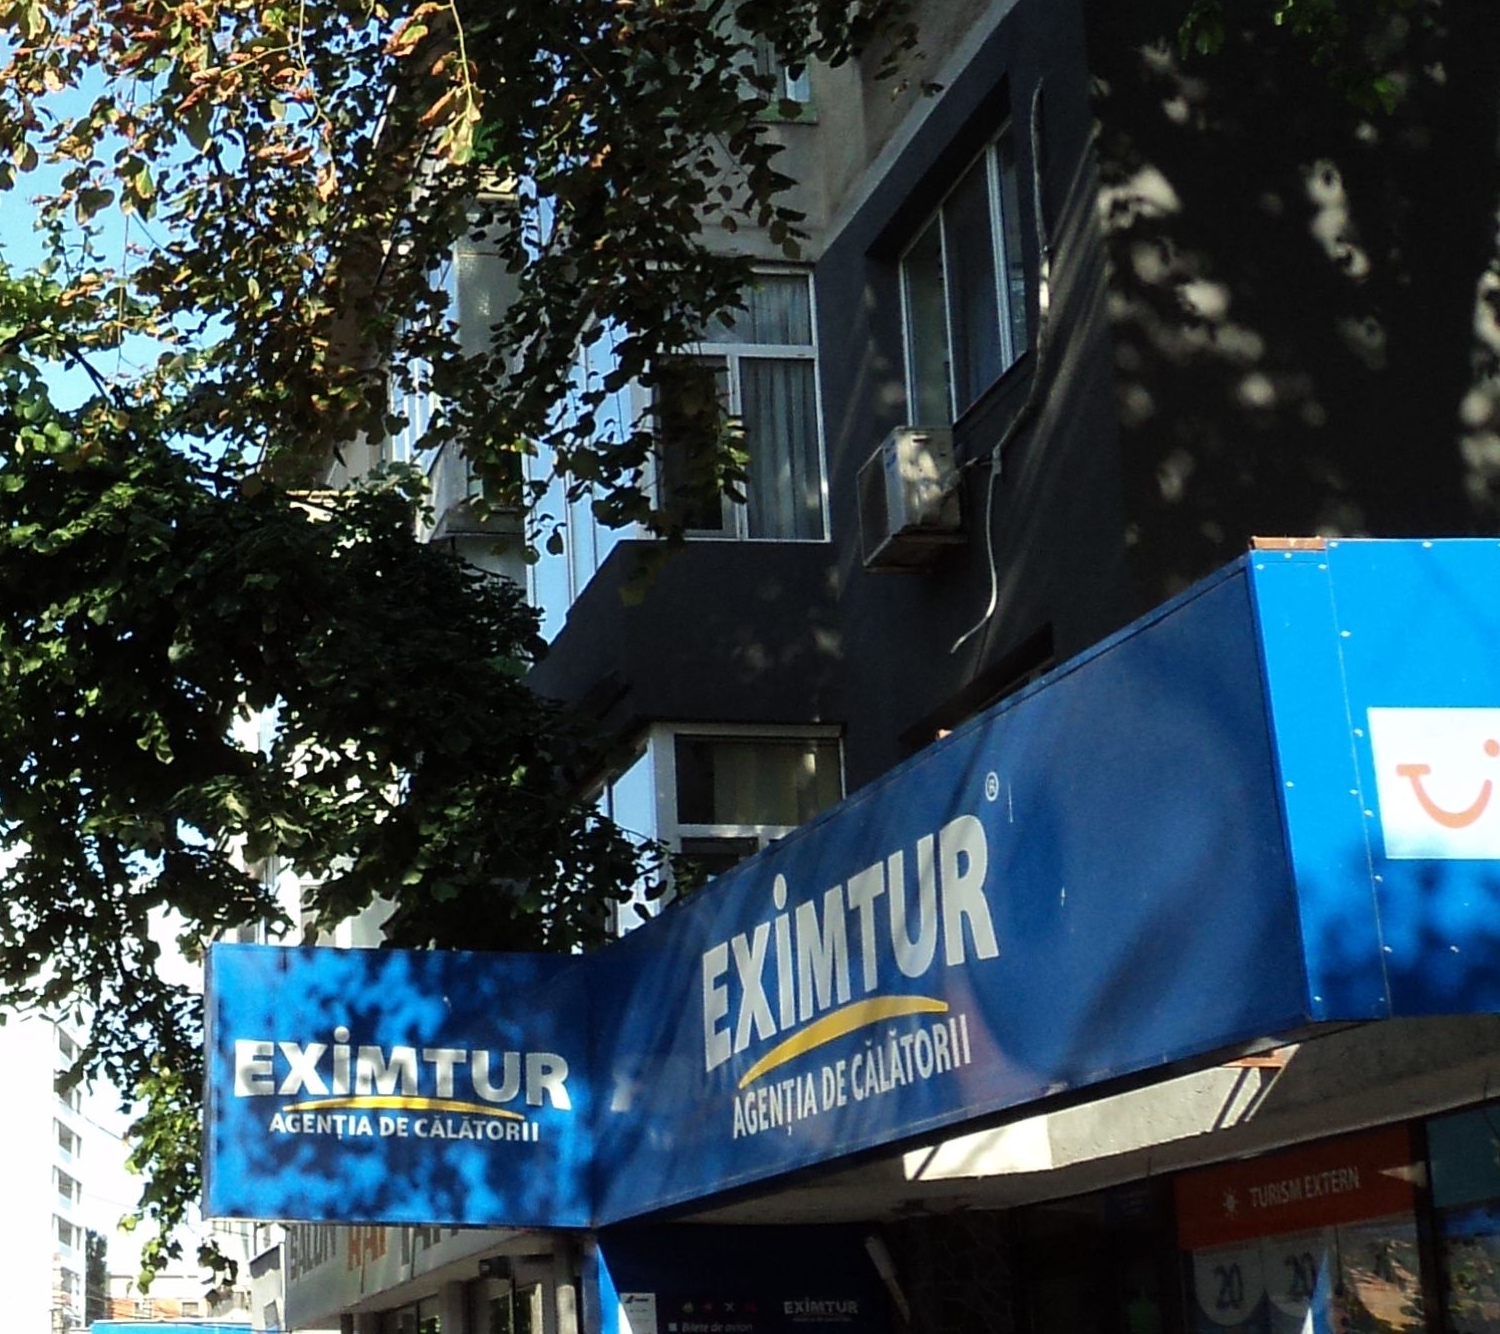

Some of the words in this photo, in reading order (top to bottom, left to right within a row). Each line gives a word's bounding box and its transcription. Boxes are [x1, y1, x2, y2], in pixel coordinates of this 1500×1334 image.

[732, 1072, 818, 1139] AGENȚIA
[822, 1060, 847, 1108] DE
[851, 1014, 972, 1101] CĂLĂTORII
[269, 1112, 374, 1140] AGENȚIA
[379, 1116, 408, 1137] DE
[417, 1116, 540, 1143] CĂLĂTORII
[1248, 1179, 1303, 1208] TURISM
[1304, 1167, 1360, 1199] EXTERN
[710, 1322, 722, 1333] de
